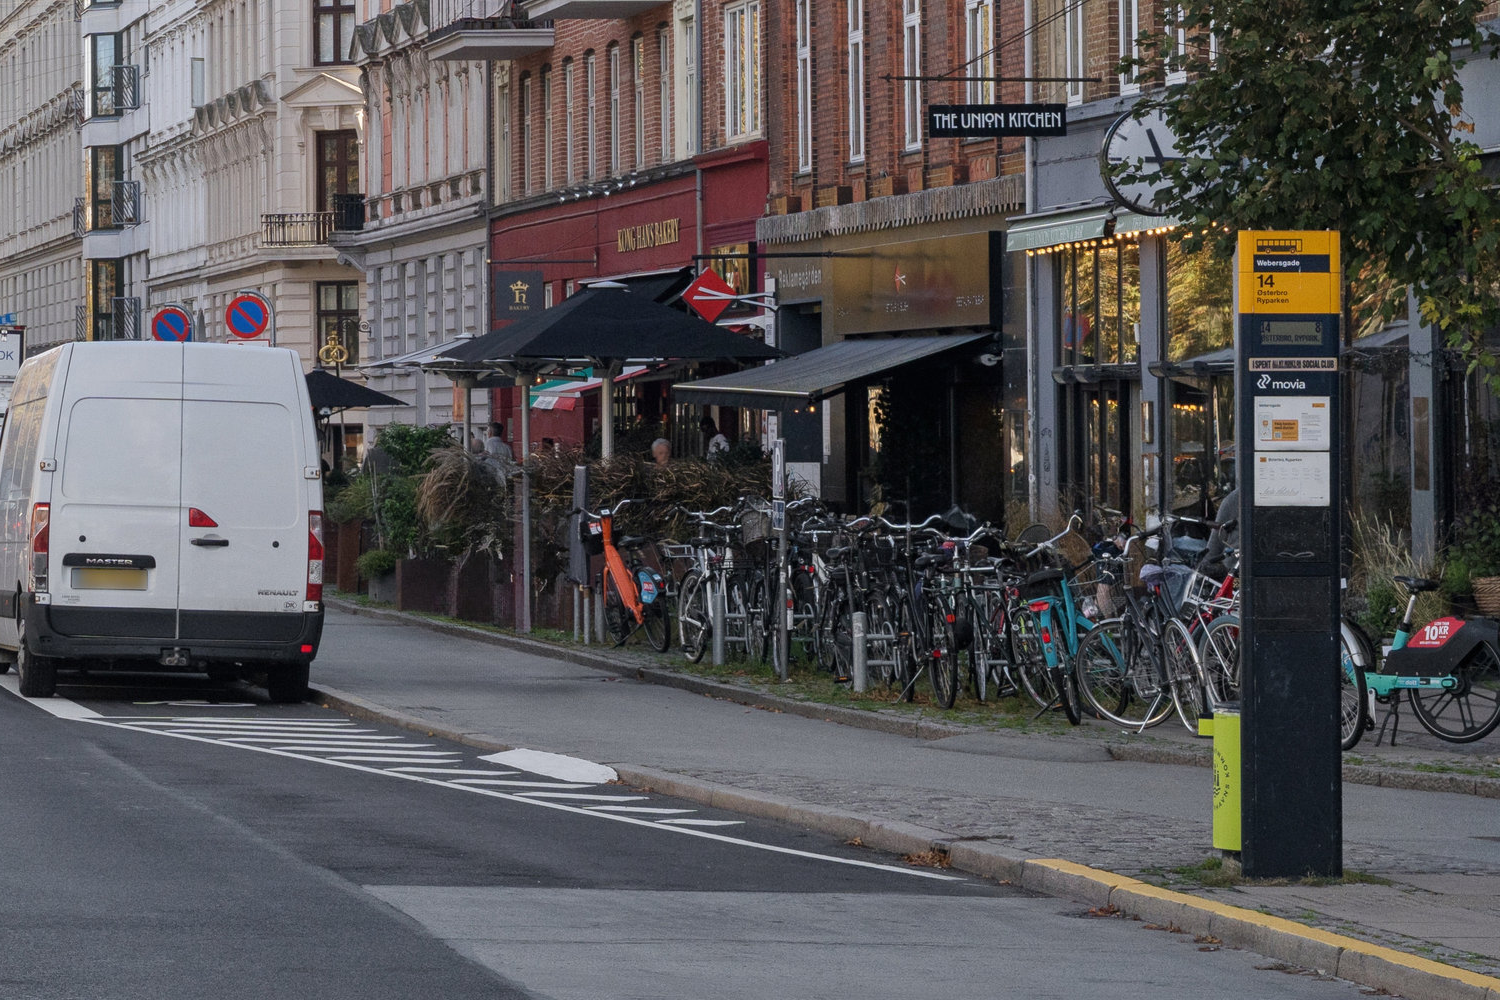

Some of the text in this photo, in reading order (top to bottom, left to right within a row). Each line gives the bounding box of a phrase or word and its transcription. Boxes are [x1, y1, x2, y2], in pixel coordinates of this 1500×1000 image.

[933, 112, 1061, 129] THE UNION KITCHEN
[617, 226, 636, 253] KONG
[654, 217, 680, 247] BAKERY
[1256, 259, 1300, 268] Webersgade
[778, 263, 822, 290] Reklamegården
[1256, 274, 1275, 288] 14
[1256, 297, 1289, 305] Ryparken
[1315, 321, 1321, 333] 8
[1302, 360, 1320, 369] SOCIAL
[1321, 360, 1335, 369] CLUB
[1272, 379, 1306, 389] movia
[1424, 625, 1450, 641] 10 KR
